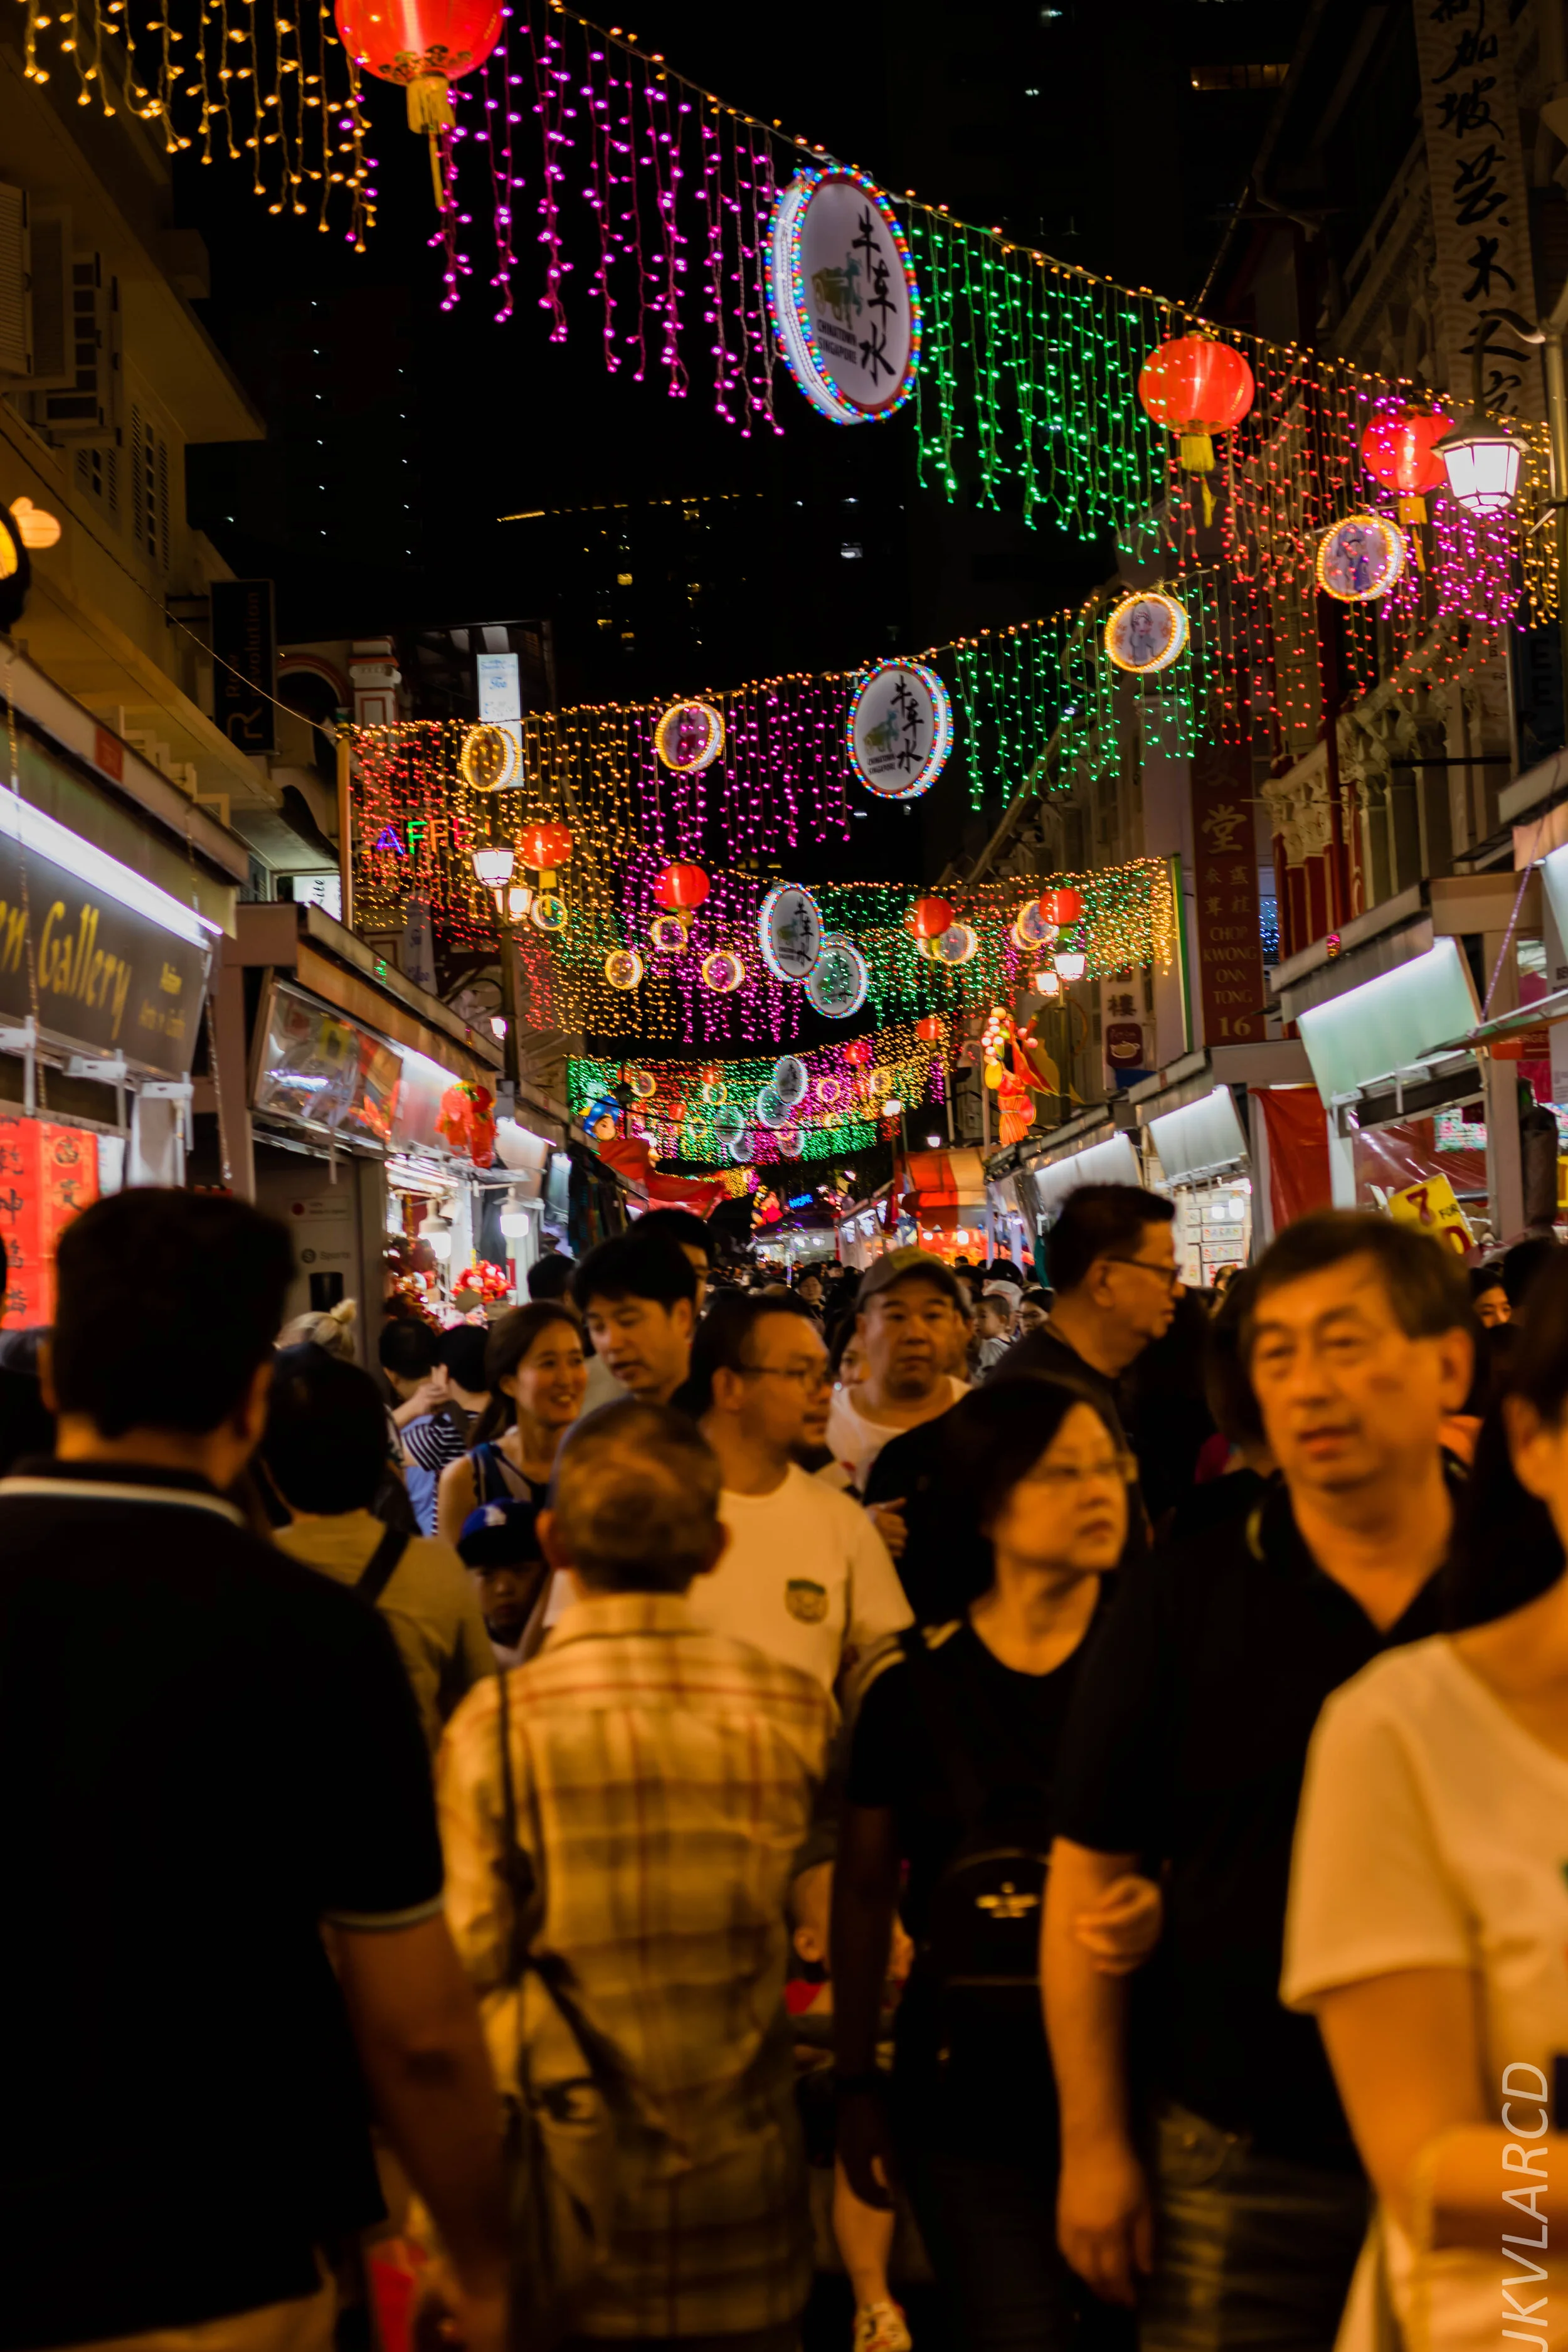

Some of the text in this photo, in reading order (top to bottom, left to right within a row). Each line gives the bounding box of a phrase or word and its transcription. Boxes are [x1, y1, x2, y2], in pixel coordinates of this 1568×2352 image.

[817, 319, 857, 347] CHINATOWN
[818, 336, 857, 364] SINGAPORE
[1209, 926, 1248, 941] CHOP
[1203, 946, 1258, 962] KWONG
[38, 901, 132, 1041] Gallery
[1216, 968, 1248, 983] ONN
[1212, 989, 1253, 1004] TONG
[1217, 1015, 1251, 1037] 16
